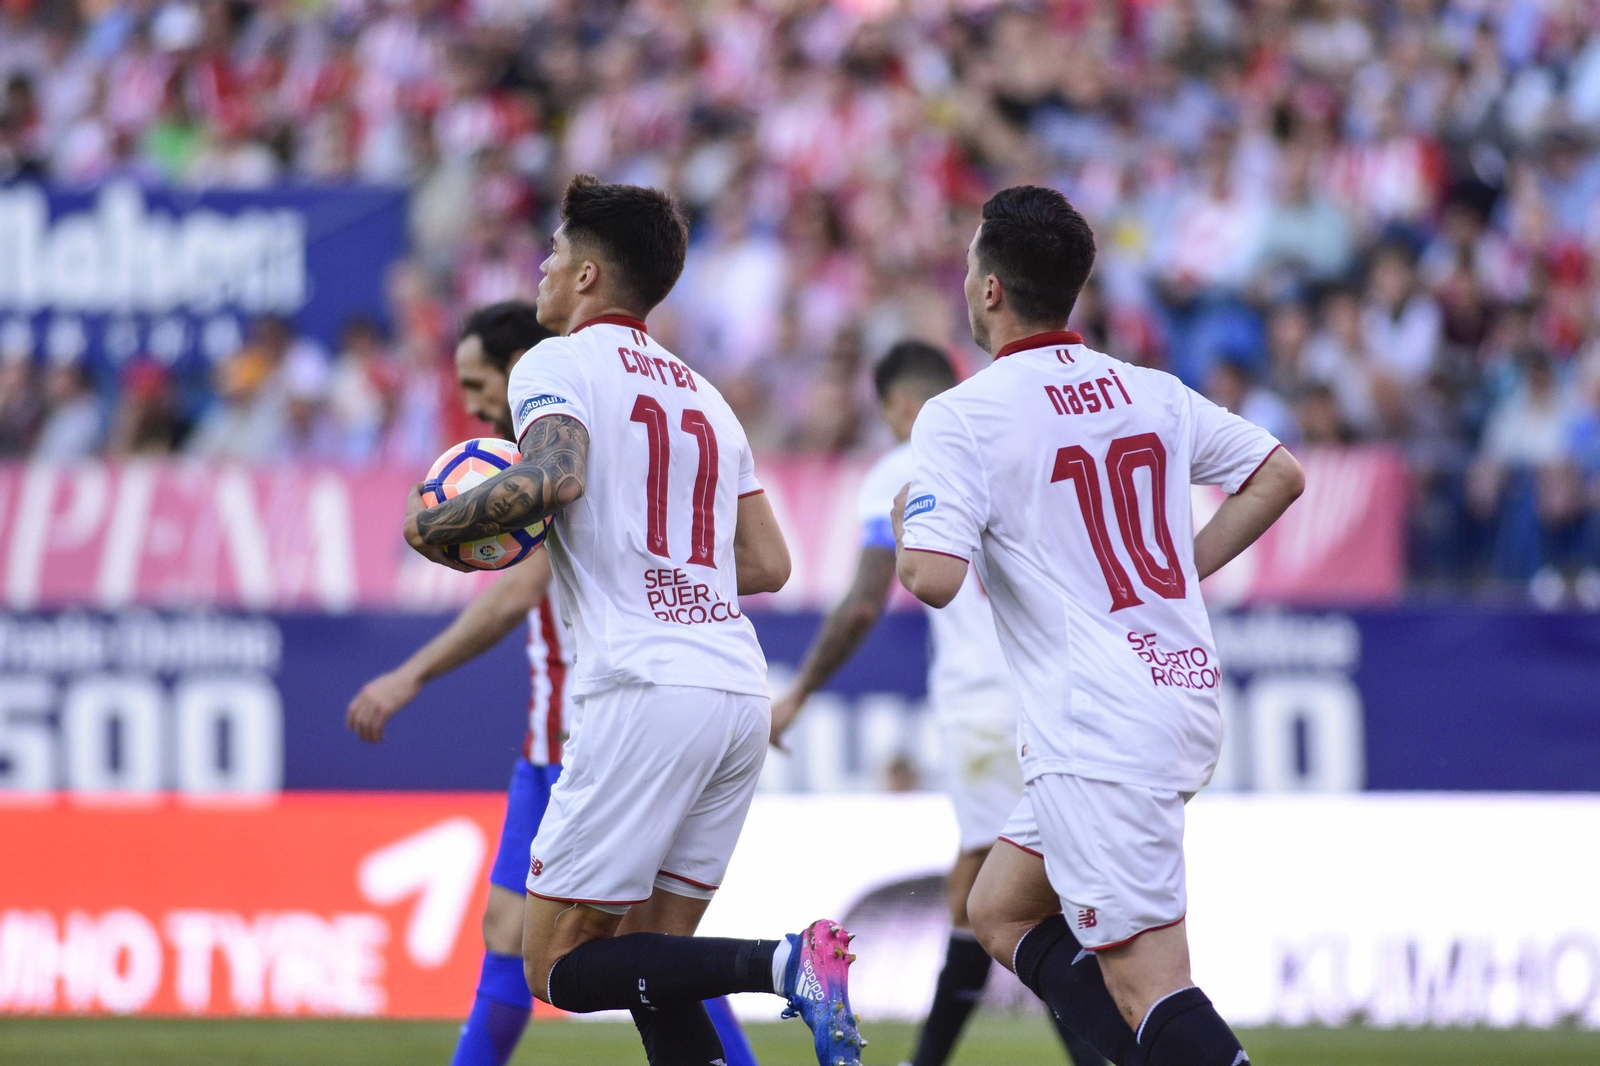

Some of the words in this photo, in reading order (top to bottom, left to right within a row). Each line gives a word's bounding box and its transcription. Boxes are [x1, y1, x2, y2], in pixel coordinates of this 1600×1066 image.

[617, 346, 698, 393] correa
[1043, 368, 1133, 416] nasri
[630, 394, 719, 570] 11
[1050, 432, 1186, 613] 10
[644, 567, 689, 589] SEE
[167, 908, 389, 1014] TYRE
[803, 959, 825, 1001] adidas
